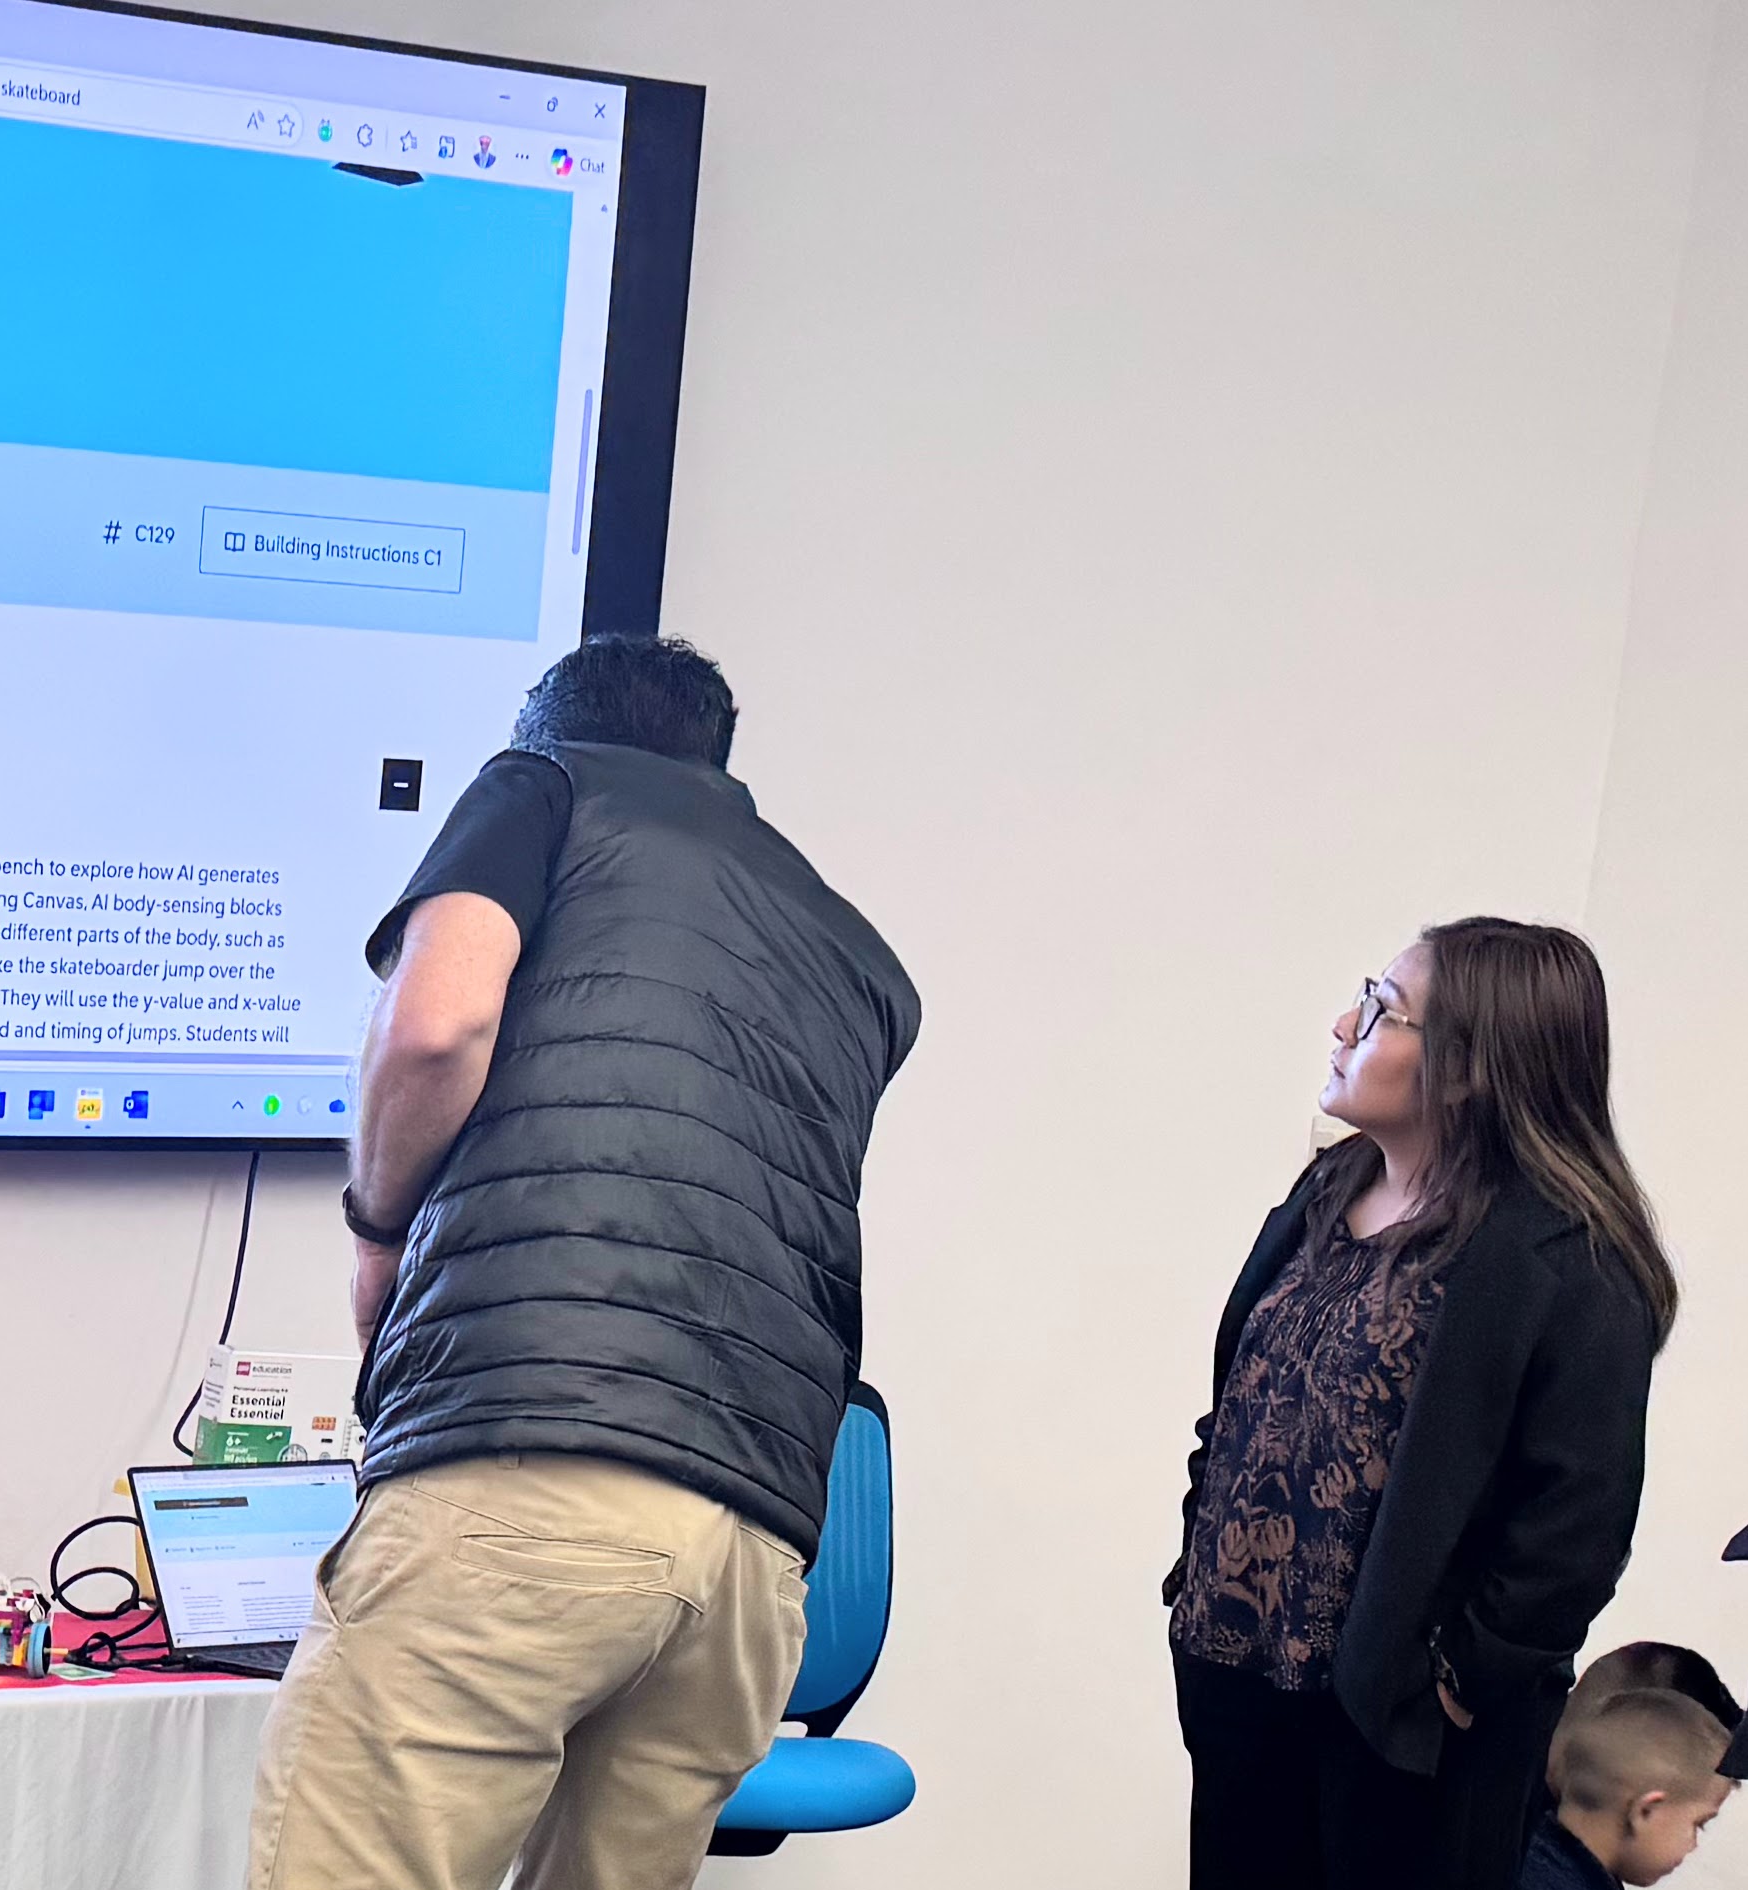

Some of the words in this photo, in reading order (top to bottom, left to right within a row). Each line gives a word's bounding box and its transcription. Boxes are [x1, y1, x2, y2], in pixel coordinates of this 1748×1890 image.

[579, 158, 605, 173] Chat
[103, 520, 123, 544] #
[135, 524, 175, 544] C129
[254, 534, 320, 560] Building
[325, 540, 420, 565] Instructions
[424, 548, 443, 567] C1
[49, 860, 66, 877] to
[70, 860, 134, 882] explore
[138, 862, 174, 880] how
[176, 865, 194, 881] AI
[198, 868, 279, 886] generates
[23, 891, 87, 911] Canvas,
[91, 894, 109, 911] AI
[113, 893, 225, 919] body-sensing
[230, 897, 282, 916] blocks
[0, 923, 72, 943] different
[77, 928, 119, 947] parts
[123, 927, 141, 945] of
[145, 927, 172, 945] the
[176, 928, 220, 951] body,
[224, 930, 263, 947] such
[267, 935, 285, 948] as
[19, 956, 46, 974] the
[50, 957, 160, 977] skateboarder
[161, 959, 205, 982] jump
[208, 966, 245, 979] over
[249, 963, 275, 980] the
[0, 989, 41, 1010] They
[45, 989, 74, 1007] will
[78, 994, 108, 1008] use
[112, 991, 139, 1008] the
[143, 993, 204, 1013] y-value
[207, 994, 239, 1010] and
[242, 995, 301, 1011] x-value
[230, 1407, 284, 1420] Essentiel
[232, 1395, 286, 1407] Essential
